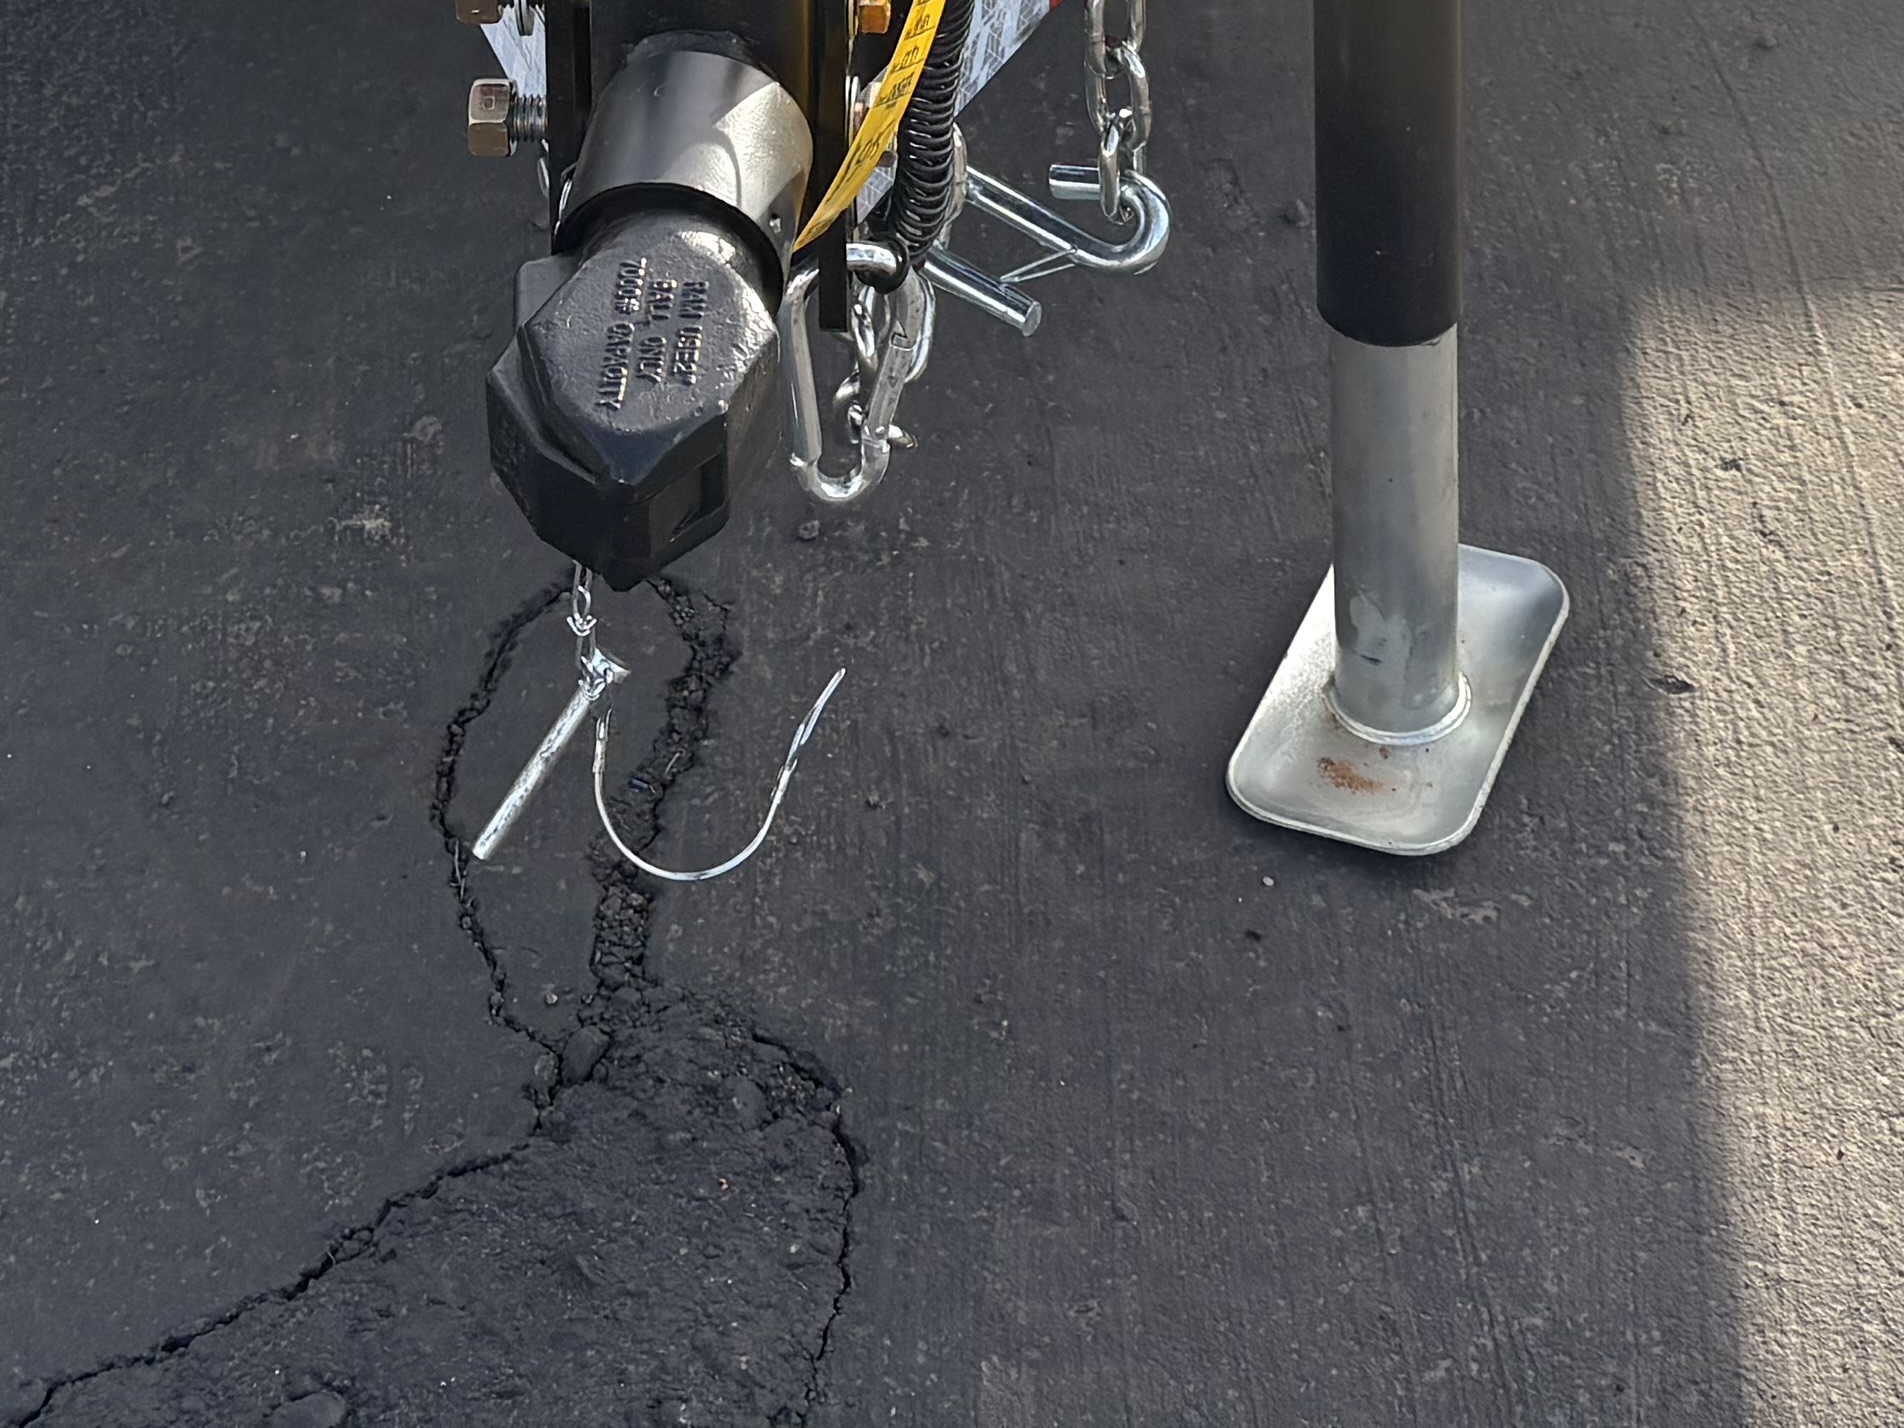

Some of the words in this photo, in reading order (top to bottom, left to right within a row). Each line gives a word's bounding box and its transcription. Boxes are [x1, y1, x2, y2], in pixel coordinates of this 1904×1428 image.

[645, 279, 678, 326] BALL
[594, 322, 636, 412] CAPACITY
[636, 336, 667, 384] ONLY
